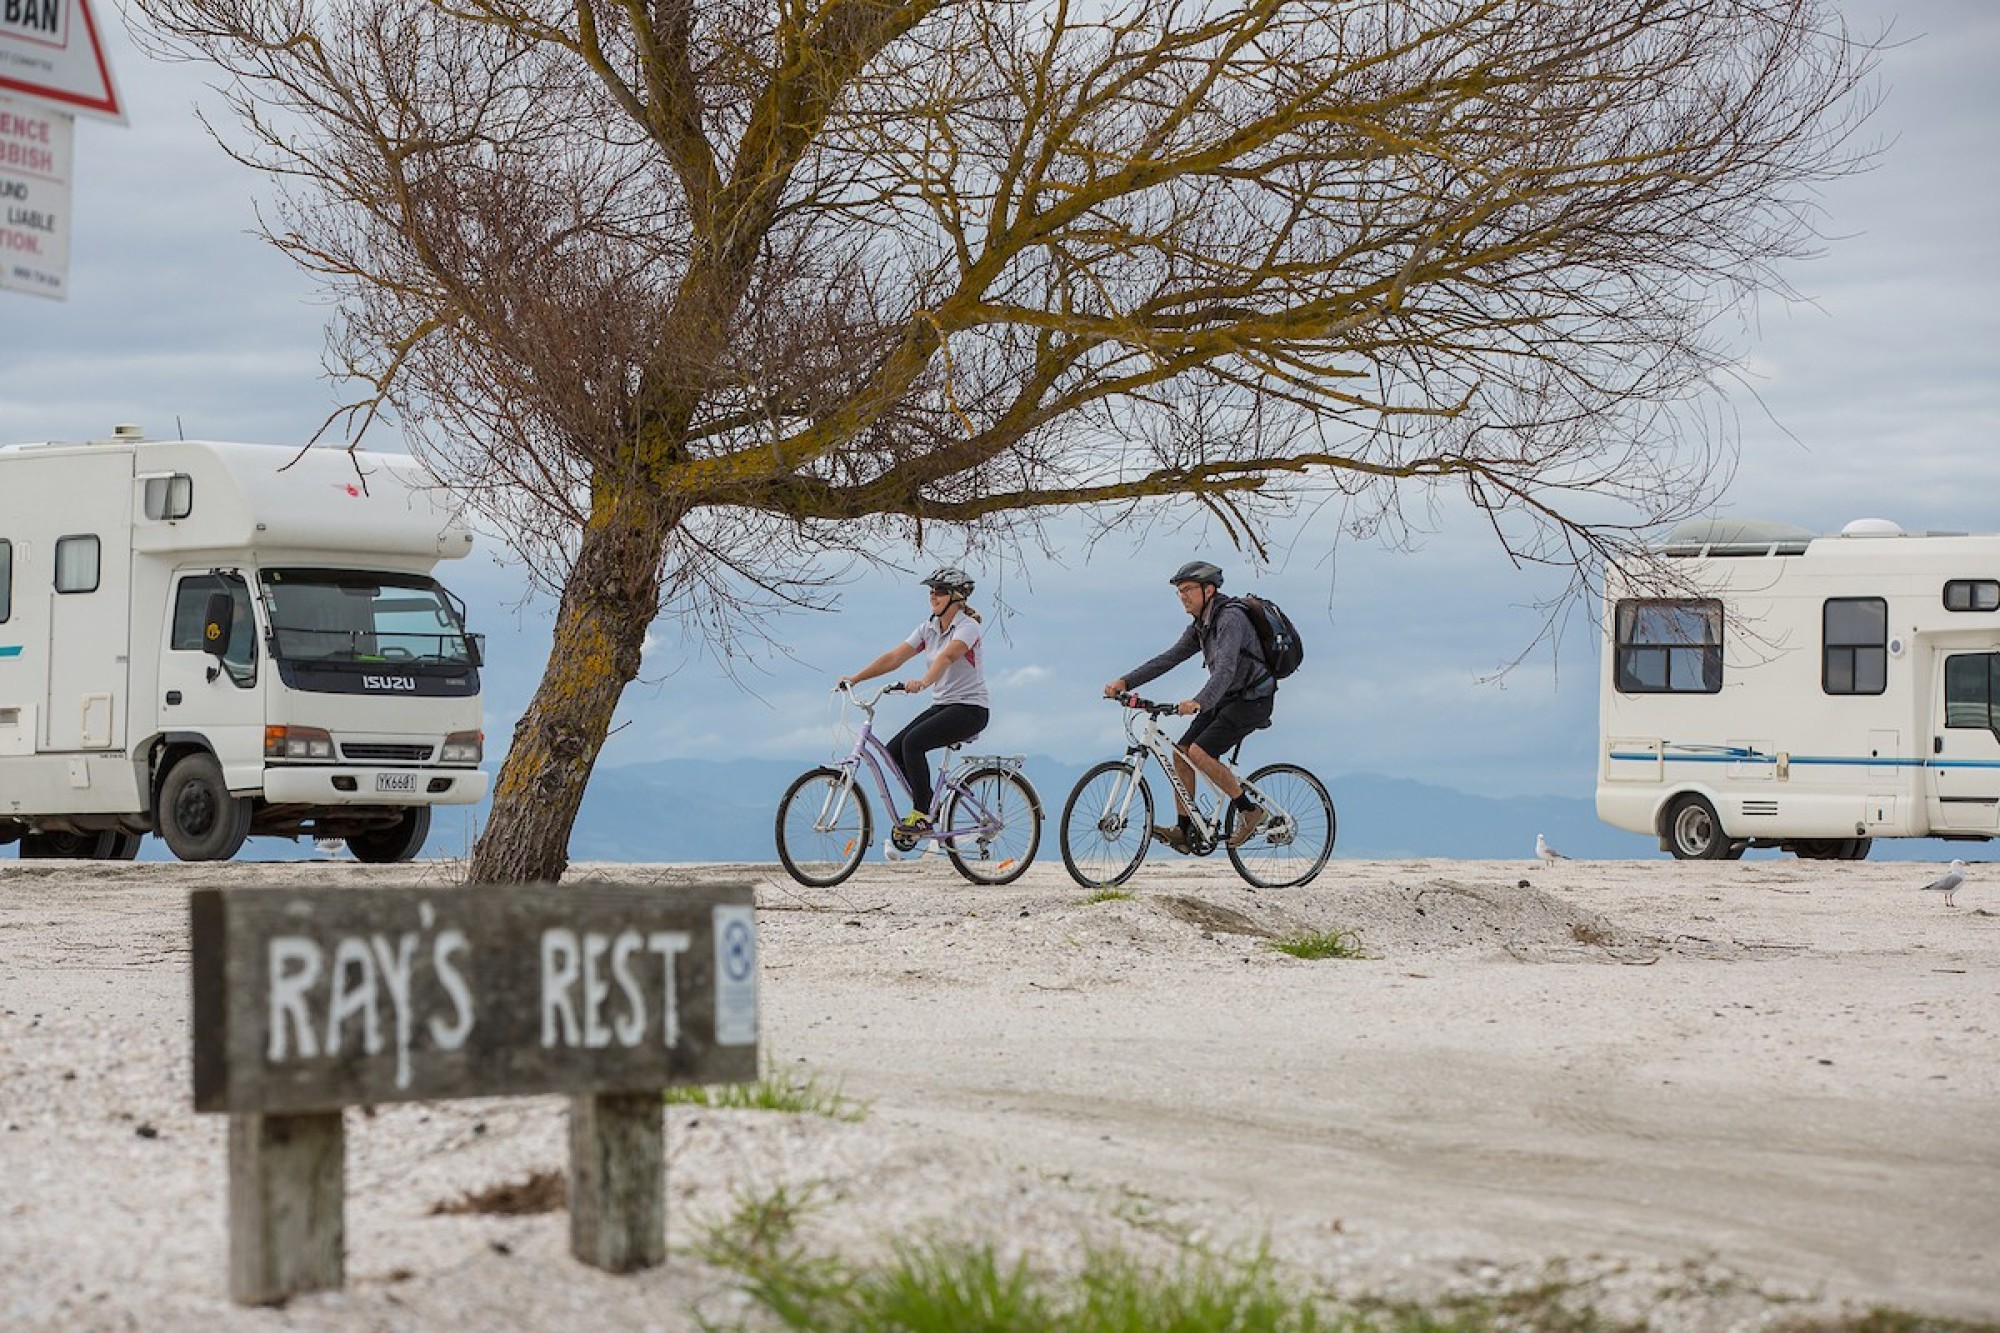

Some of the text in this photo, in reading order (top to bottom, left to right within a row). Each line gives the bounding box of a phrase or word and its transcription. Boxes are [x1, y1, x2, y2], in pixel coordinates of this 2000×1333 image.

[4, 0, 59, 34] BAN
[7, 206, 55, 233] LIABLE
[362, 675, 416, 691] ISUZU
[267, 901, 690, 1090] RAY'S REST
